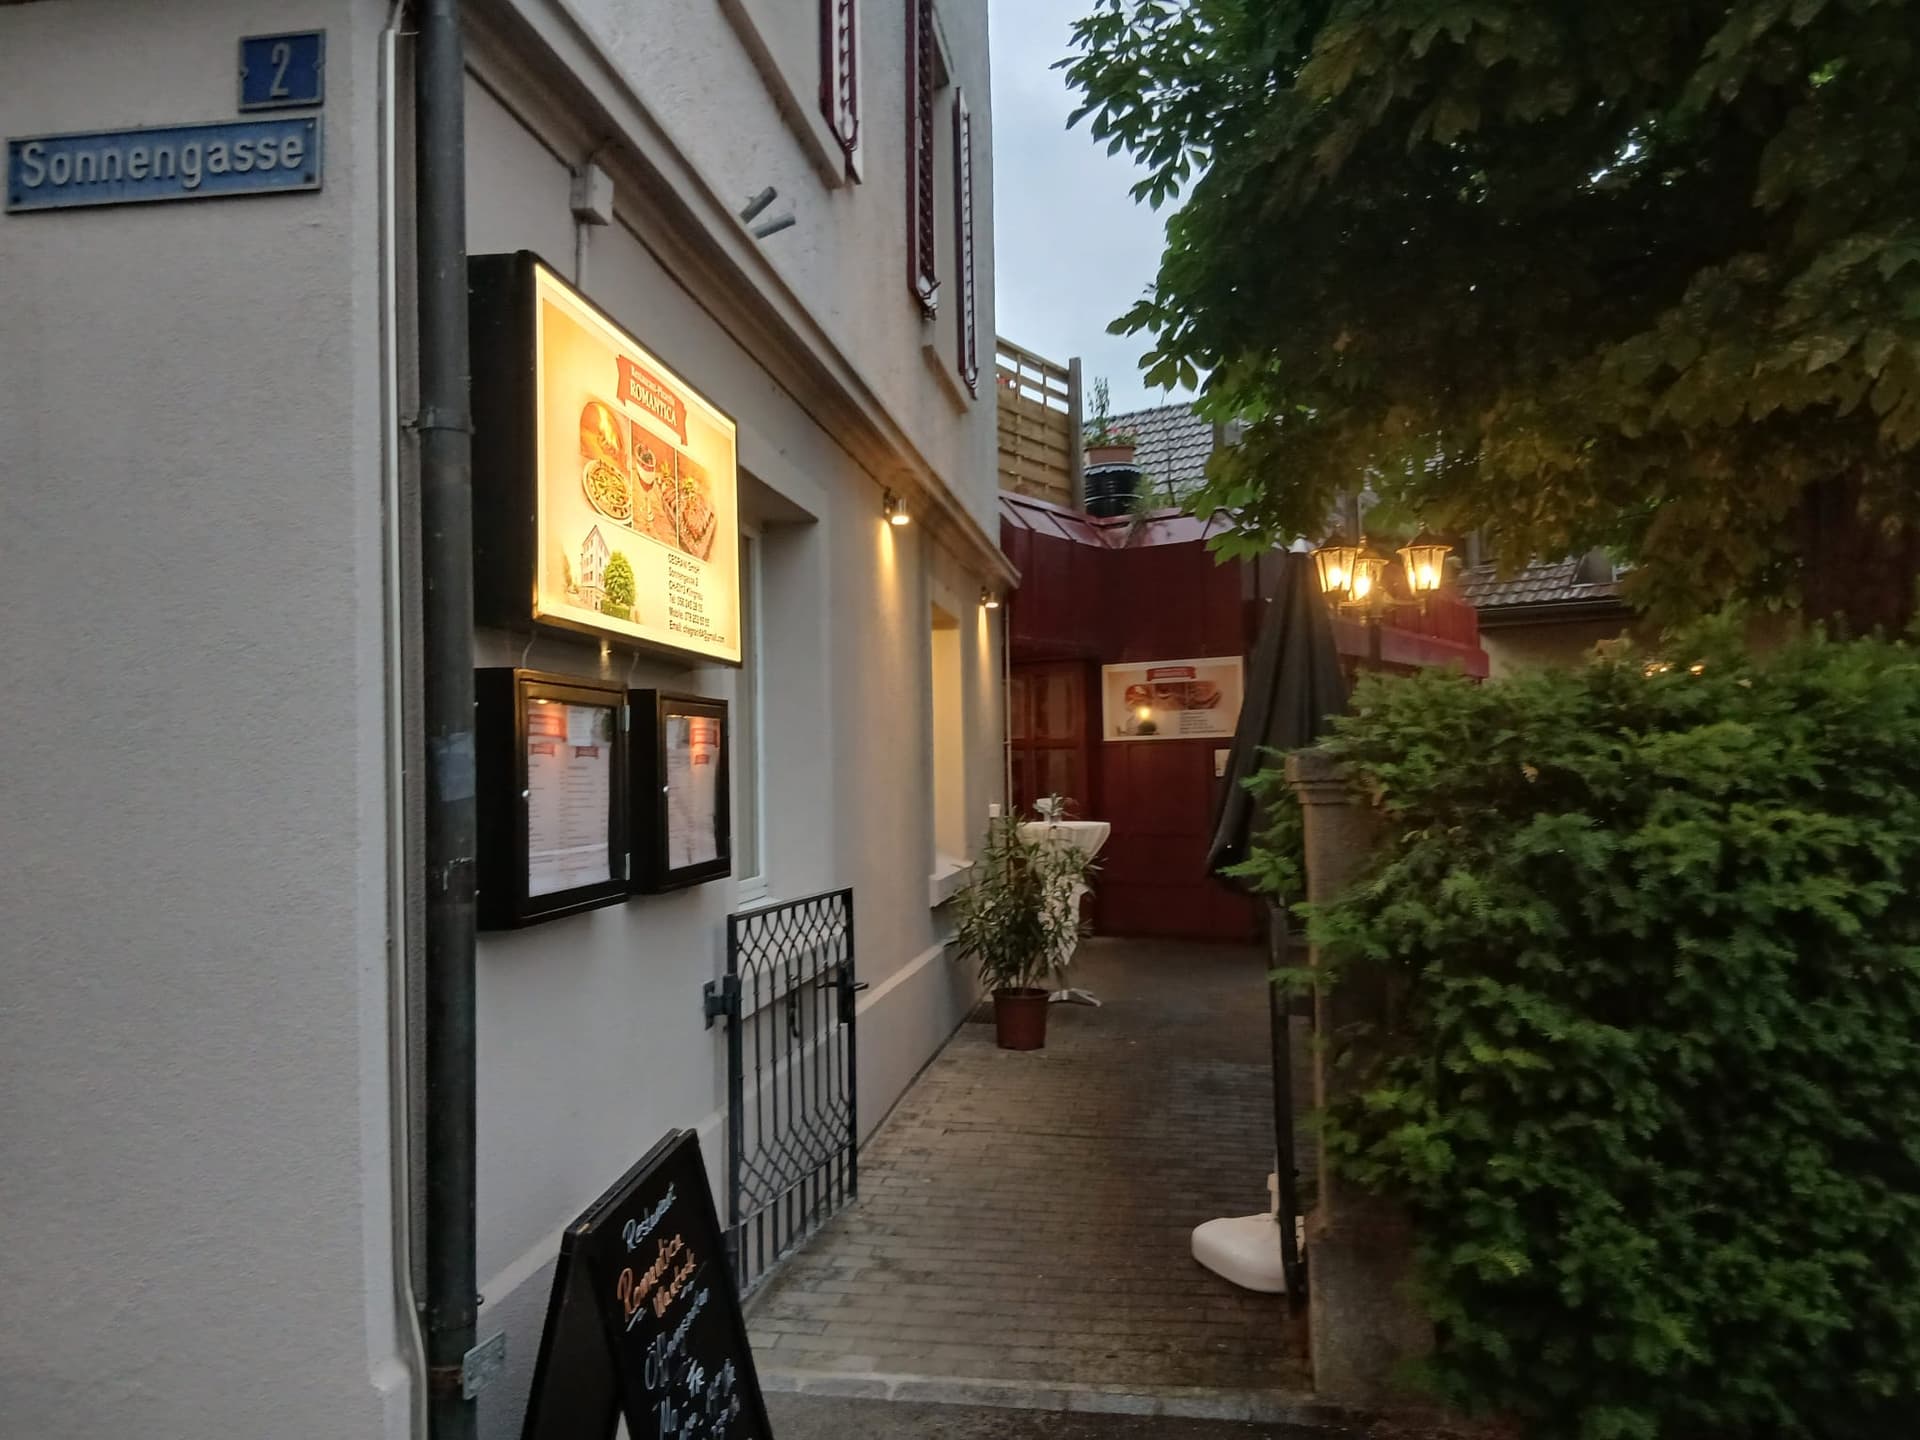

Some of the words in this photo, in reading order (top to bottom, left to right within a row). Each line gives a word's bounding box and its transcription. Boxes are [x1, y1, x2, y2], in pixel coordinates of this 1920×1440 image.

[269, 42, 291, 97] 2
[20, 134, 303, 189] Sonnengasse
[630, 378, 677, 427] ROMANTICA
